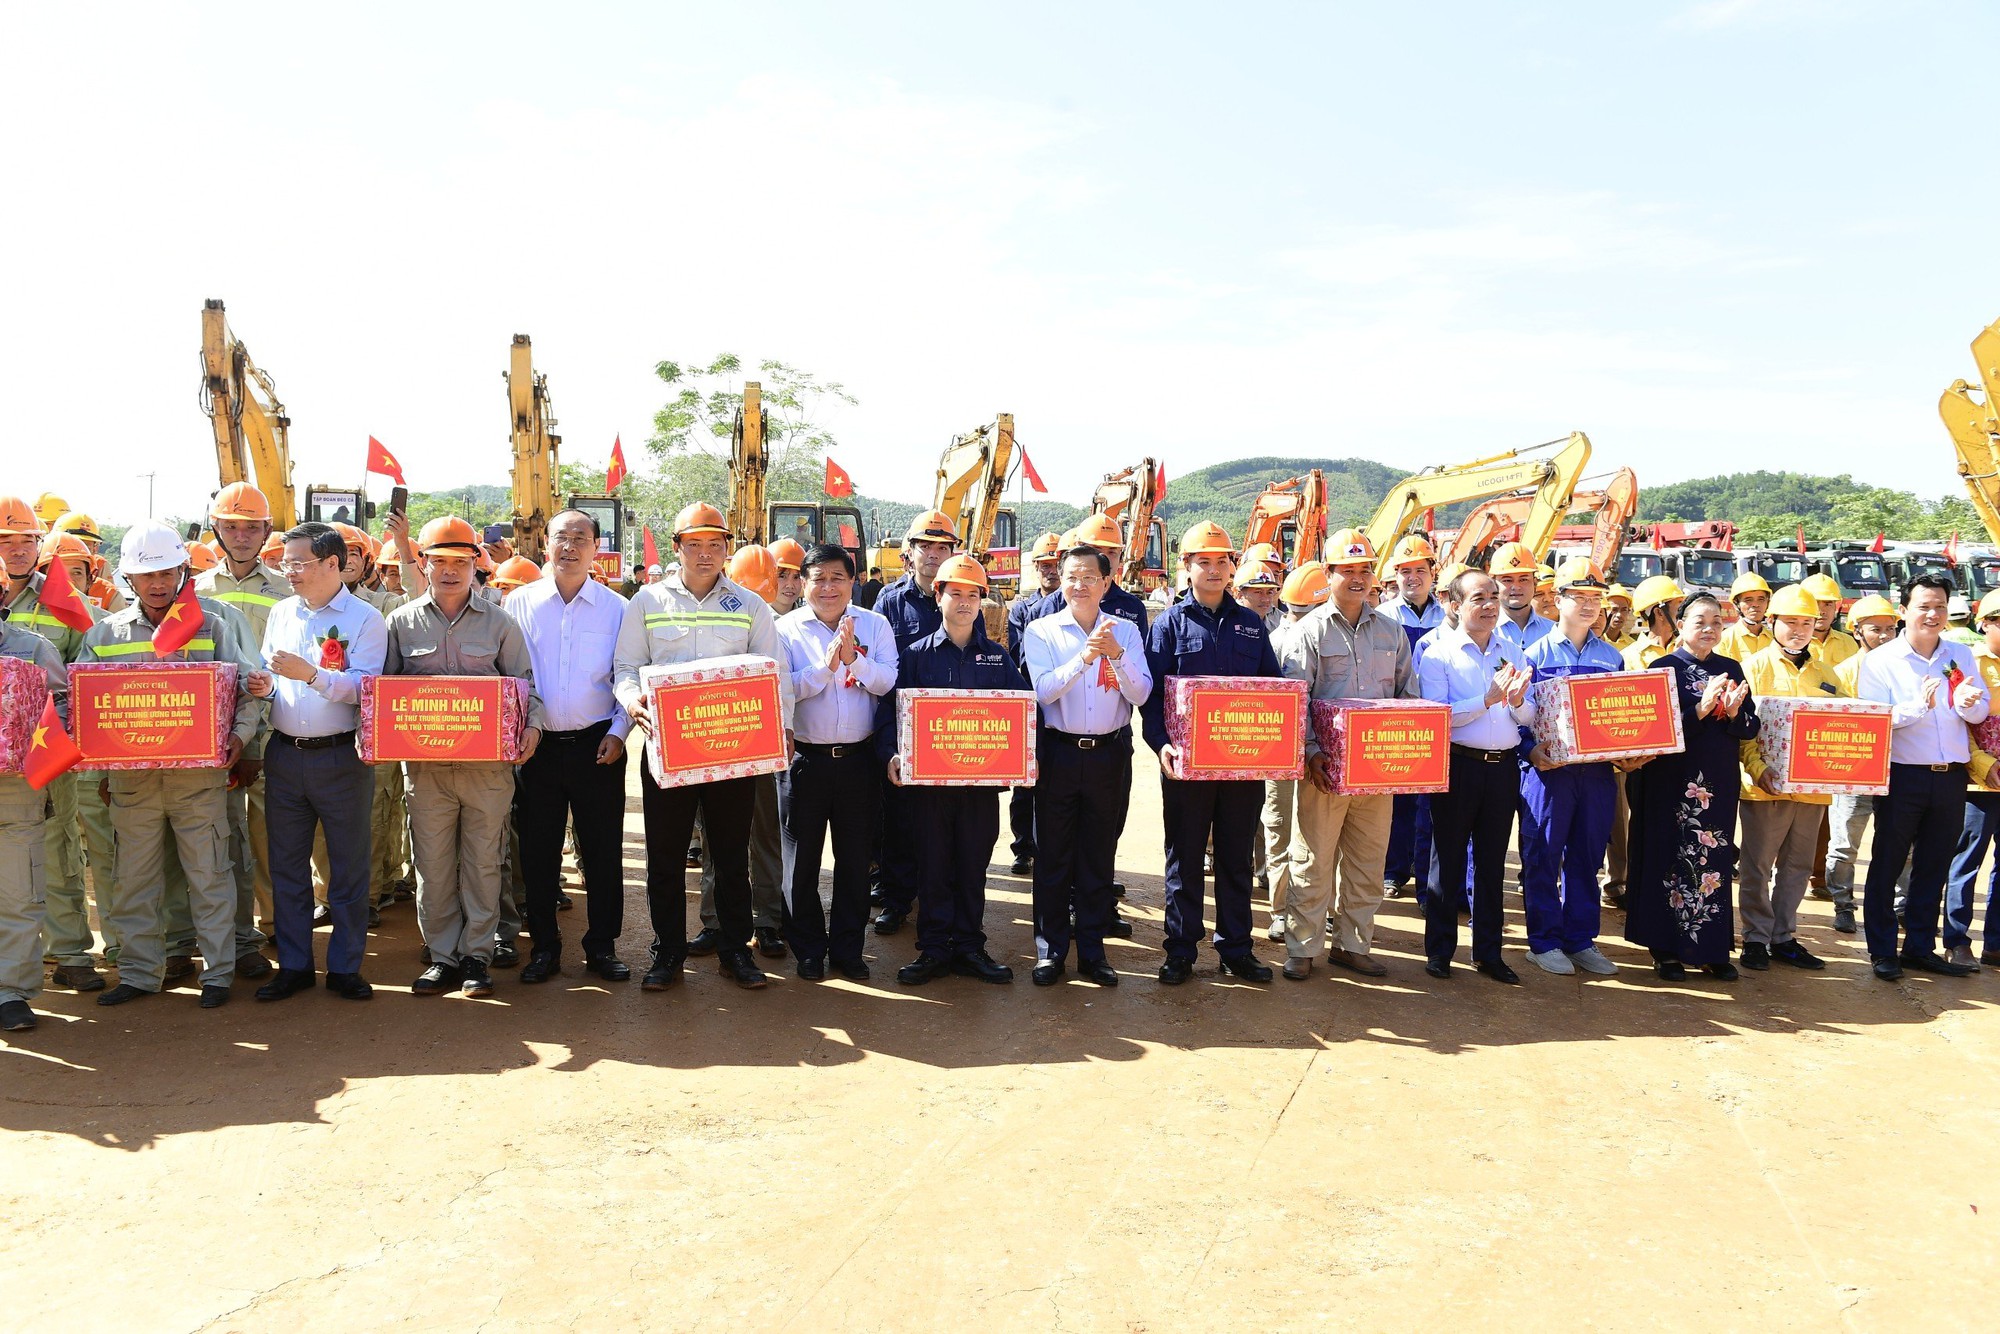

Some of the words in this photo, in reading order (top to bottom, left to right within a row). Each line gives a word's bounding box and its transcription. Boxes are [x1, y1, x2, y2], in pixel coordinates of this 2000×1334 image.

[1477, 476, 1505, 488] LICOGI
[609, 557, 618, 576] ĐỘ
[444, 686, 460, 694] CHÍ
[94, 693, 111, 709] LÊ
[116, 694, 156, 708] MINH
[161, 691, 195, 707] KHÁI
[392, 697, 407, 711] LÊ
[412, 699, 448, 711] MINH
[452, 697, 484, 712] KHÁI
[1585, 697, 1598, 710] LÊ
[1601, 696, 1629, 708] MINH
[1632, 692, 1657, 706] KHÁI
[100, 711, 107, 719] BÍ
[676, 706, 691, 721] LÊ
[695, 703, 729, 719] MINH
[733, 697, 762, 714] KHÁI
[1208, 710, 1221, 723] LÊ
[1224, 712, 1255, 723] MINH
[1258, 710, 1284, 724] KHÁI
[929, 718, 943, 731] LÊ
[947, 720, 979, 732] MINH
[983, 718, 1011, 732] KHÁI
[123, 732, 165, 745] Tặng
[1362, 729, 1374, 742] LÊ
[1377, 731, 1406, 742] MINH
[1409, 728, 1434, 741] KHÁI
[1609, 727, 1638, 737] Tặng
[1806, 729, 1818, 741] LÊ
[1821, 731, 1849, 742] MINH
[1852, 731, 1876, 743] KHÁI
[417, 735, 456, 747] Tặng
[704, 739, 740, 751] Tặng
[1228, 744, 1260, 756] Tặng
[952, 752, 985, 764] Tặng
[1381, 762, 1410, 773] Tặng
